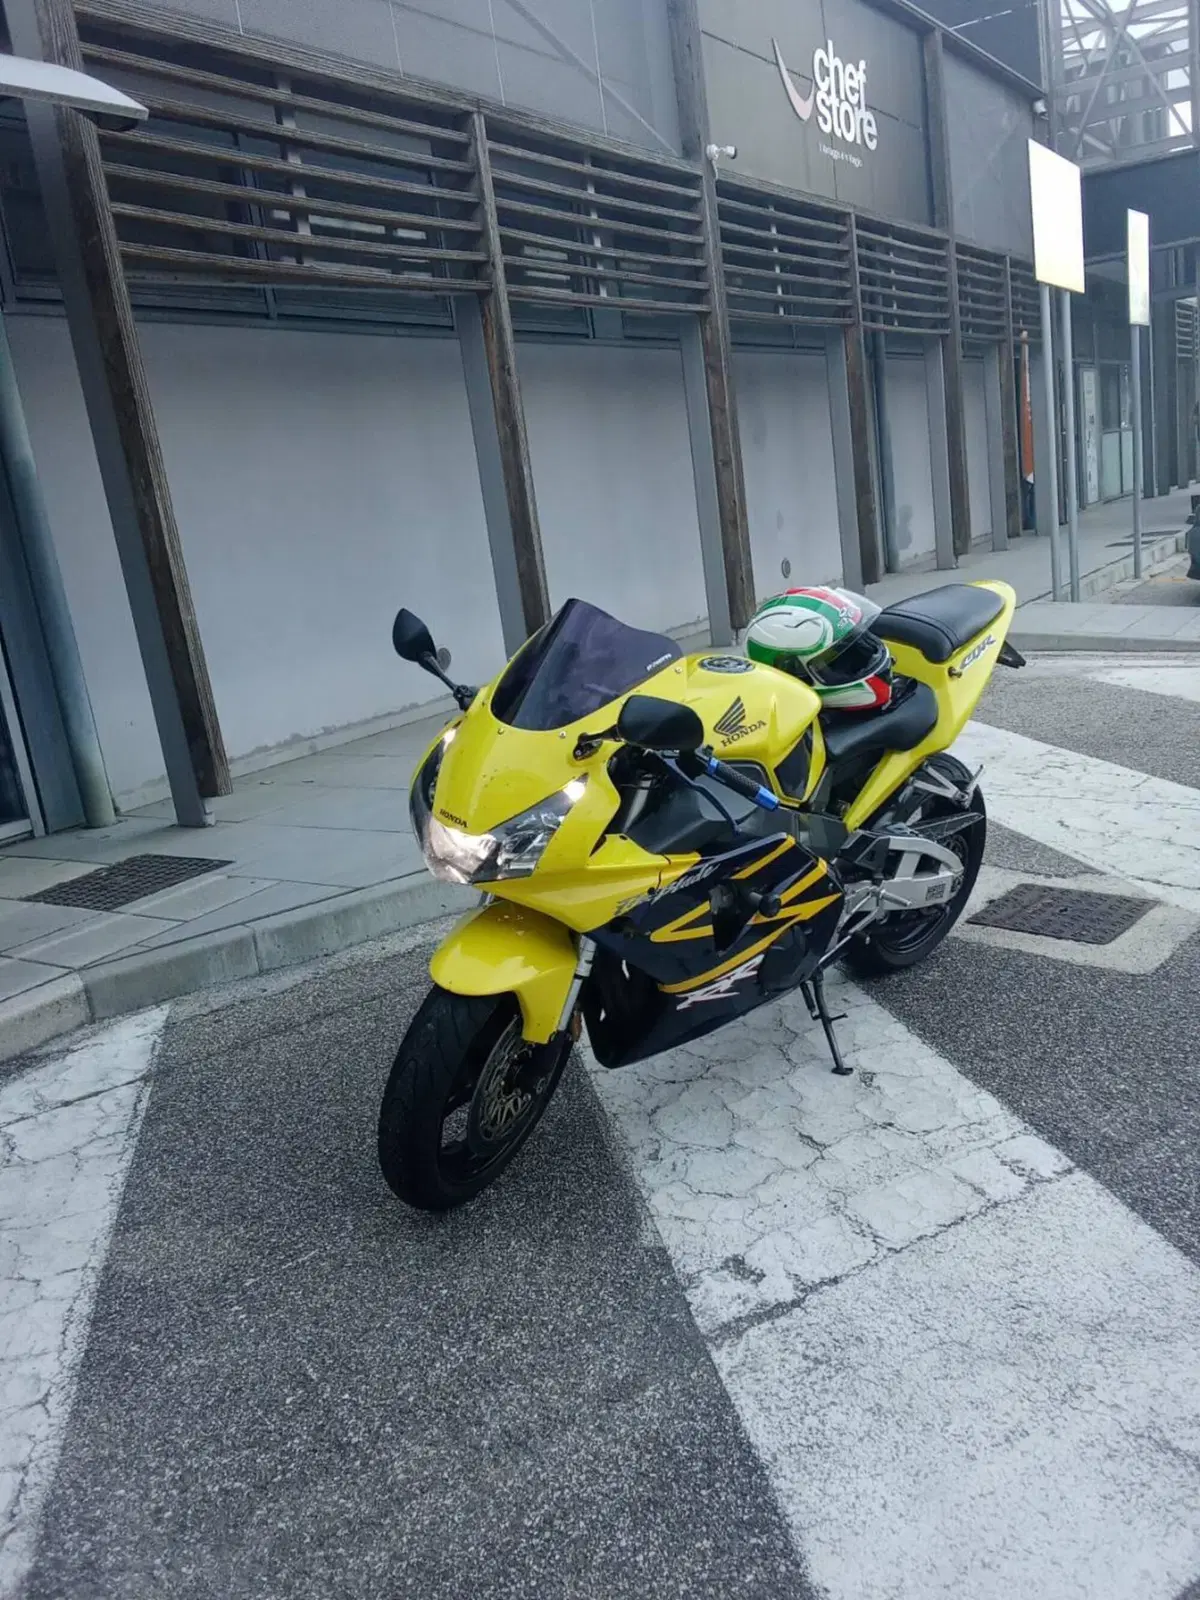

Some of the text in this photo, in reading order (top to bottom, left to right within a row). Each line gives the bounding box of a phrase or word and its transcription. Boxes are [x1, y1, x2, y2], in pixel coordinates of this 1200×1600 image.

[813, 39, 867, 112] chef
[815, 90, 878, 150] store
[720, 719, 767, 747] HONDA
[439, 808, 468, 828] HONDA
